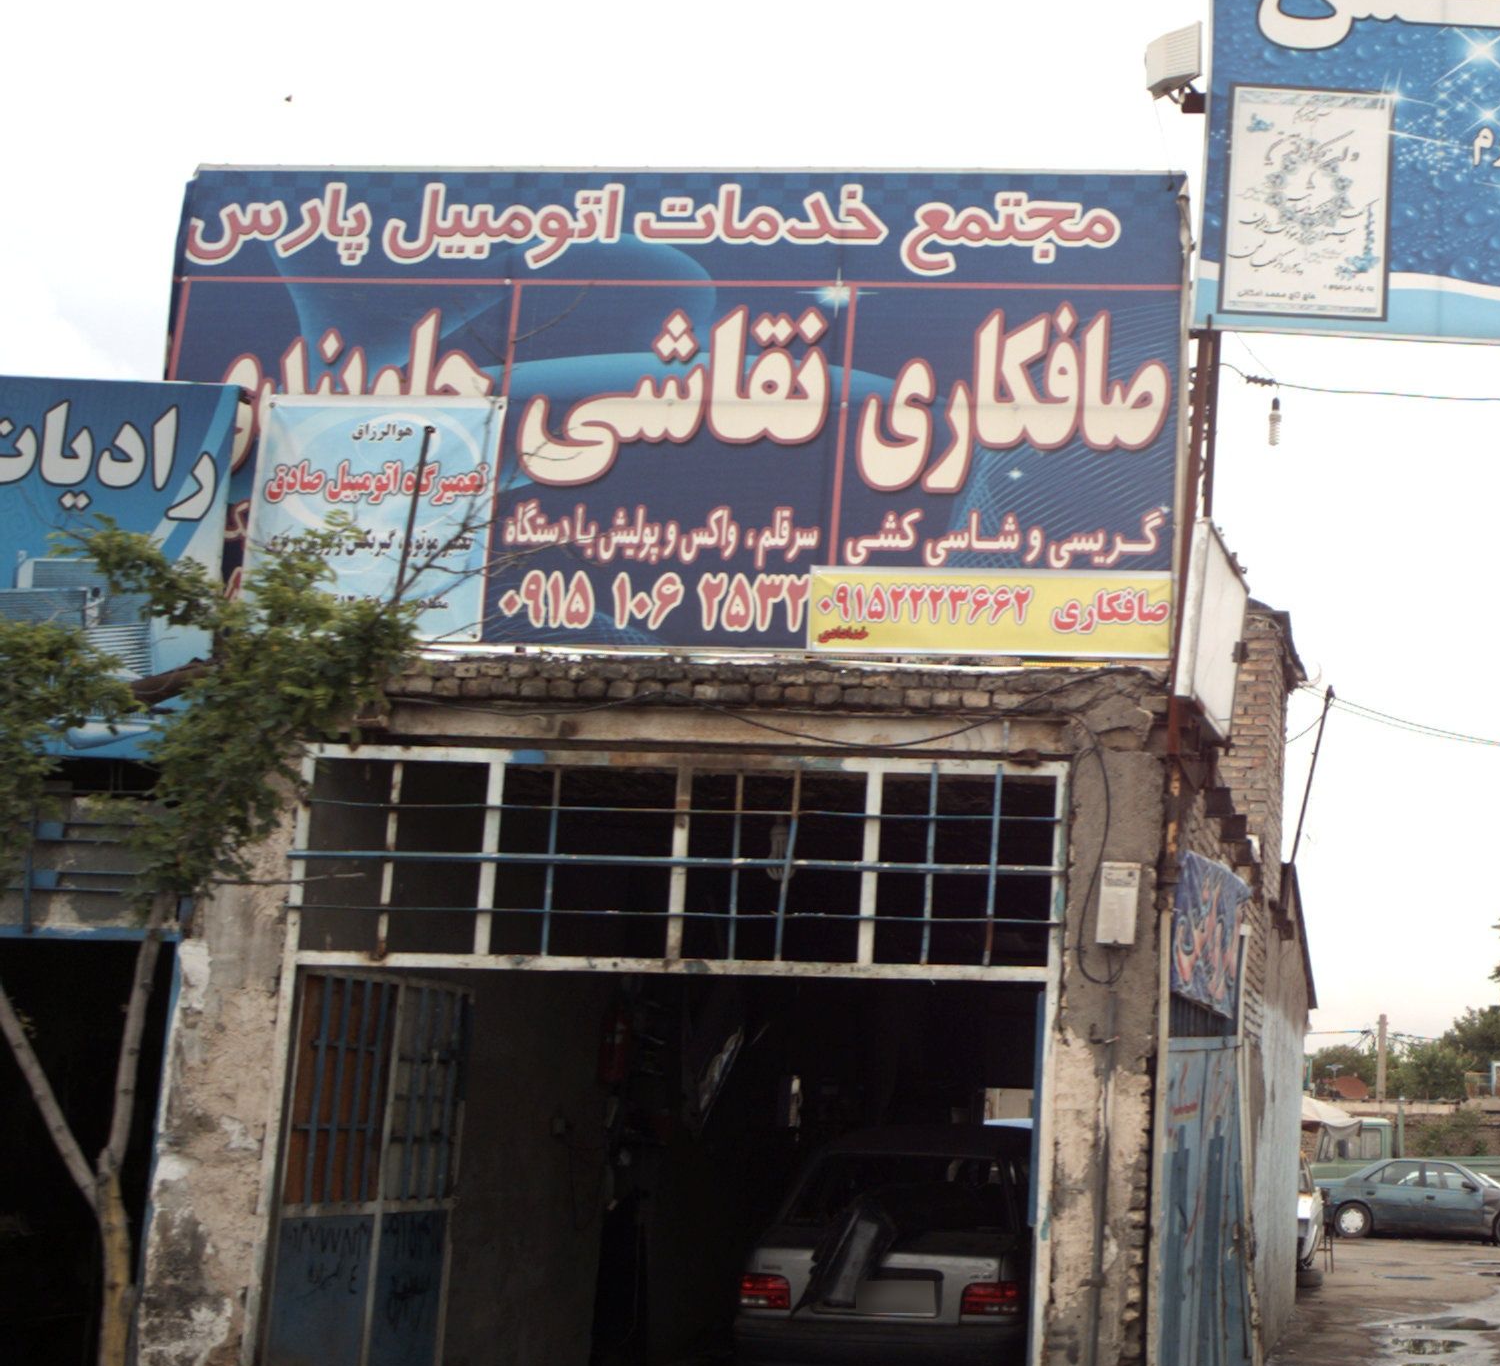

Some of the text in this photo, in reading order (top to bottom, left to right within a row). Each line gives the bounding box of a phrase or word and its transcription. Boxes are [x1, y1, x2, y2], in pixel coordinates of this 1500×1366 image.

[185, 181, 1121, 273] مجتمع خدمات اتومبیل پارس
[519, 303, 832, 485] نقاشی
[857, 303, 1172, 496] صافکاری
[265, 459, 326, 504] صادق
[326, 459, 402, 506] اتومبیل
[504, 498, 571, 546] دستگاه
[573, 502, 598, 558] با
[598, 503, 662, 565] پولیش
[663, 521, 679, 557] و
[679, 504, 740, 562] واکس
[844, 507, 925, 566] کشی
[922, 505, 1022, 568] شاسی
[1024, 526, 1045, 564] و
[498, 568, 596, 630] ۰۹۱۵
[611, 570, 686, 631] ۱۰۶
[1051, 588, 1171, 634] صافکاری
